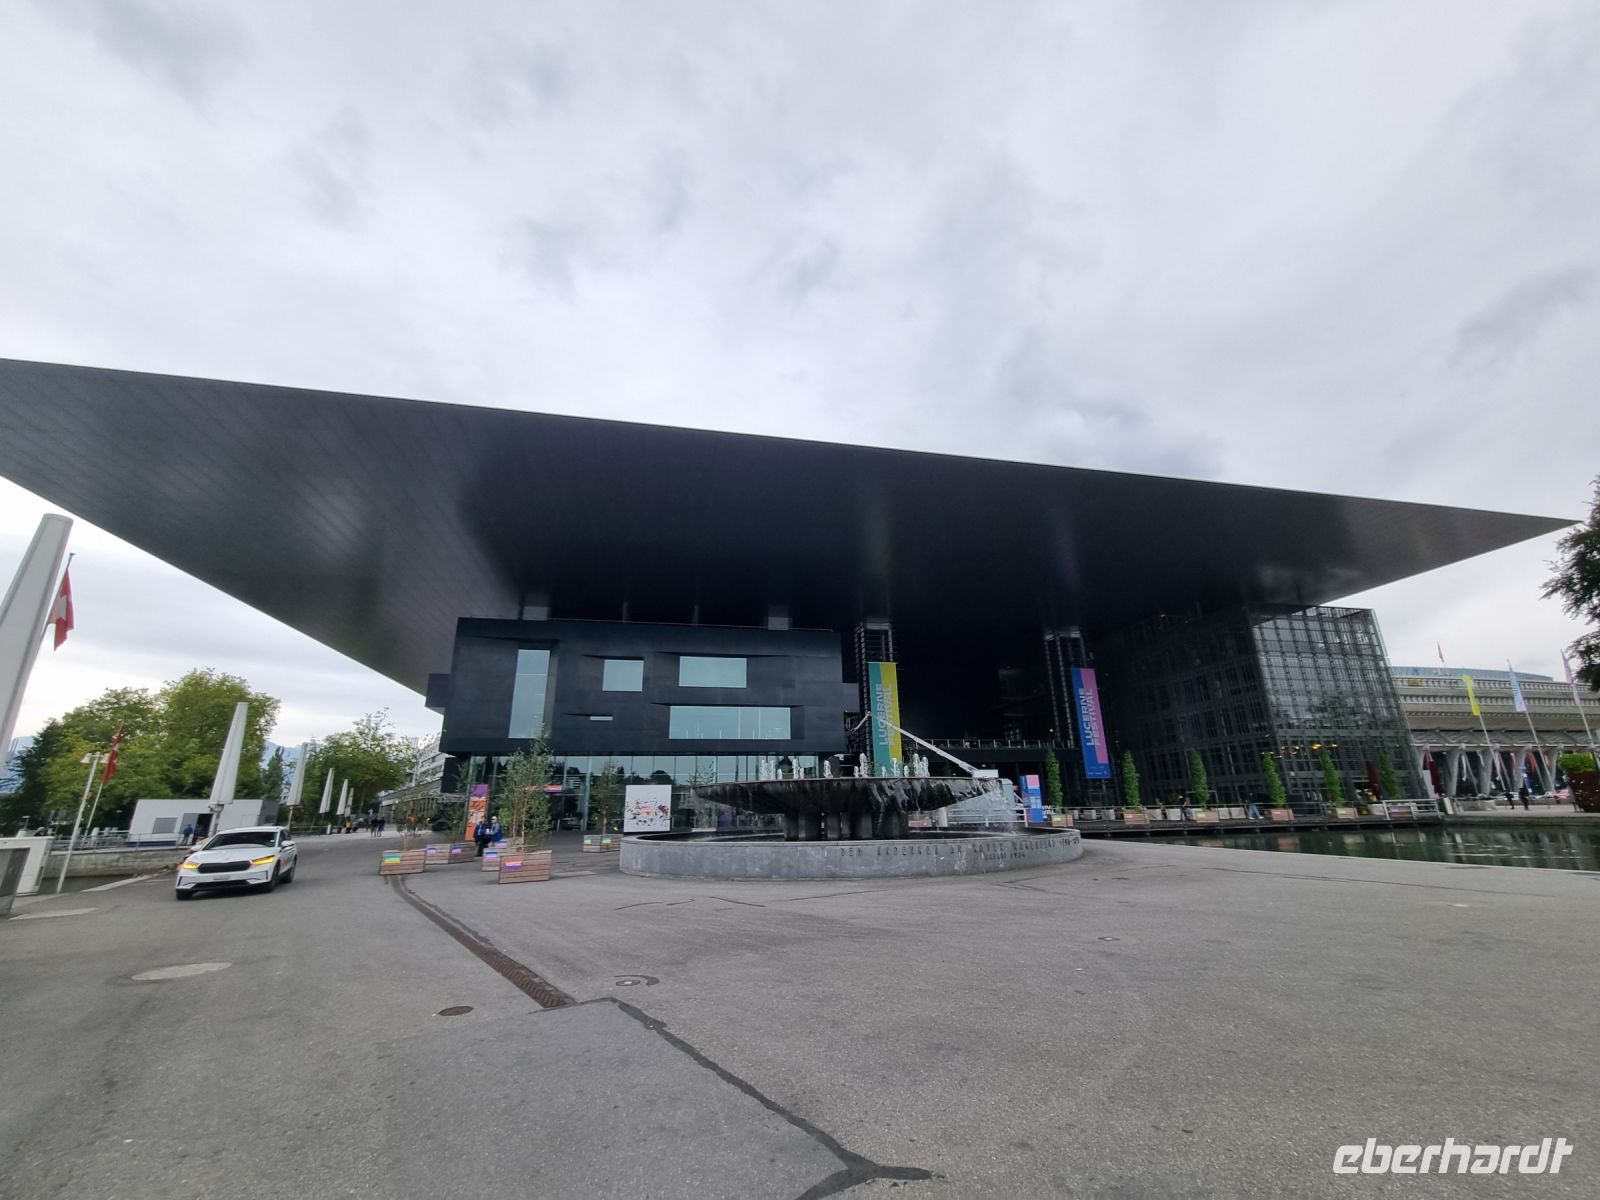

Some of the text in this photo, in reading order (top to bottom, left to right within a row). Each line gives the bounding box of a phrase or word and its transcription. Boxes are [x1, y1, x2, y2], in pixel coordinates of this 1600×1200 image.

[876, 683, 889, 746] LUCERNE
[1079, 687, 1095, 746] LUCERNE
[1084, 688, 1101, 746] FESTIVAL
